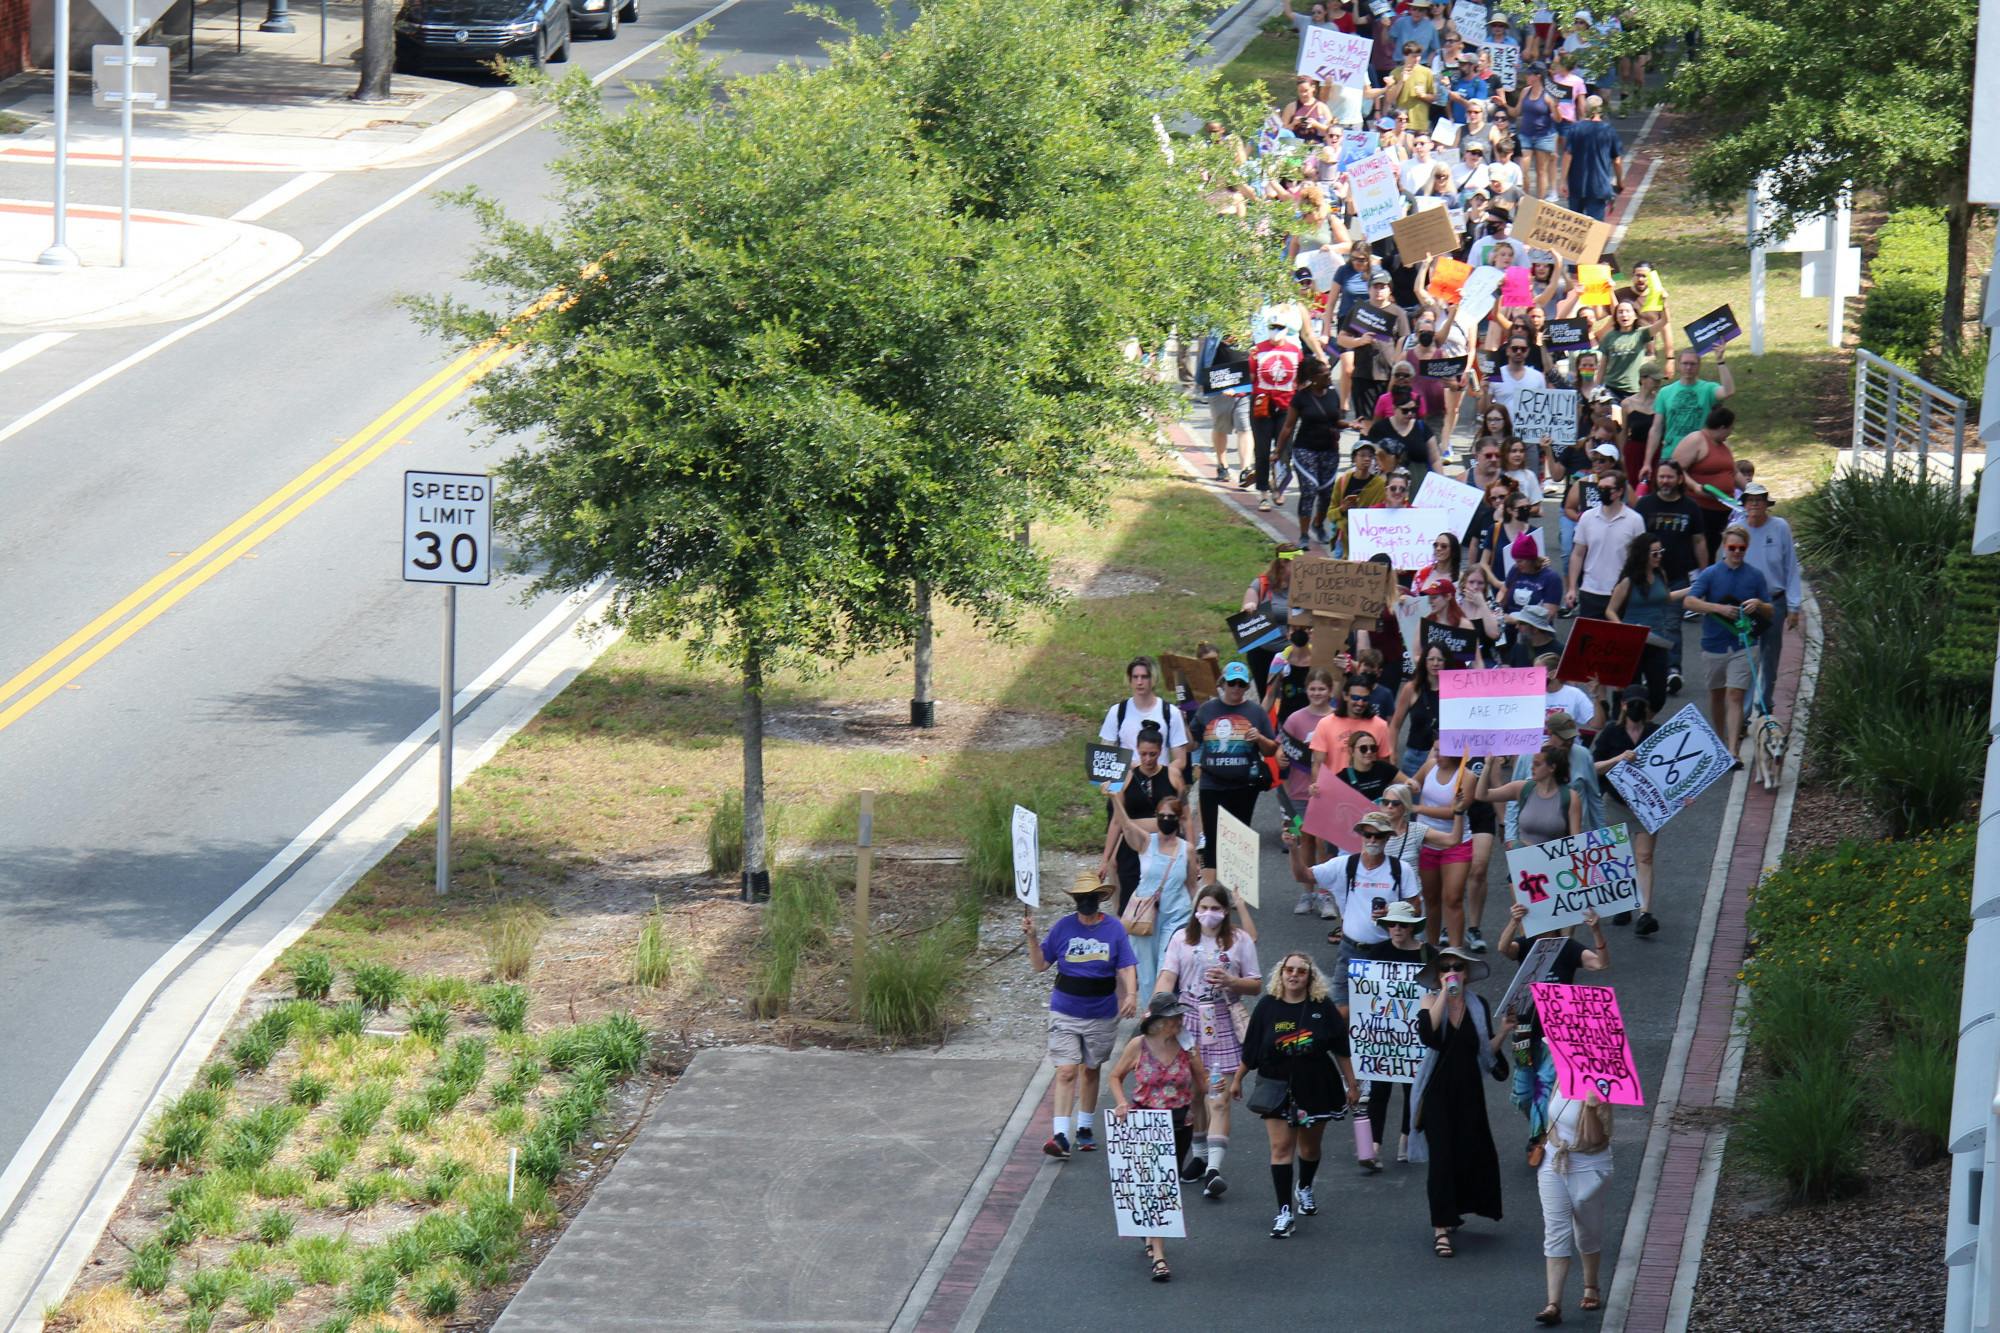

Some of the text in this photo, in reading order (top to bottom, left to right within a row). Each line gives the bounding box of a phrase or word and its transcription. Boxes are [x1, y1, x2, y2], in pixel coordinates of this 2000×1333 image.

[1501, 72, 1514, 87] MY
[1540, 206, 1555, 218] YOU
[1560, 222, 1587, 239] SAFE
[1529, 228, 1587, 255] ABORTION
[1518, 389, 1576, 418] REALLY!
[412, 482, 484, 502] SPEED
[419, 506, 476, 525] LIMIT
[1351, 513, 1411, 537] Womens
[412, 530, 478, 573] 30
[1369, 536, 1411, 552] Rights
[1294, 562, 1382, 579] PROTECT ALL
[1314, 592, 1357, 608] UTERUS
[1428, 625, 1453, 638] BANS
[1452, 671, 1537, 690] SATURDAYS
[1468, 703, 1519, 719] ARE FOR
[1503, 732, 1538, 746] RIGHTS
[1092, 759, 1127, 772] OFF OUR
[1093, 750, 1118, 762] BANS
[1092, 767, 1122, 780] BODIES
[1536, 824, 1629, 861] WE ARE
[1569, 845, 1619, 872] NOT
[1555, 855, 1635, 890] OVARY-
[1551, 878, 1641, 917] ACTING!
[1348, 960, 1372, 979] IF
[1376, 962, 1402, 980] THE
[1352, 976, 1420, 1000] YOU SAVE
[1531, 983, 1613, 1003] WE NEED
[1371, 996, 1414, 1020] GAY
[1540, 999, 1616, 1023] TO TALK
[1275, 1022, 1296, 1033] PRIDE
[1357, 1012, 1420, 1033] WILL YO
[1544, 1012, 1620, 1034] ABOUT THE
[1350, 1025, 1420, 1046] CONTINUE
[1549, 1025, 1624, 1049] ELEPHANT
[1354, 1041, 1411, 1059] PROTECT
[1569, 1043, 1622, 1059] IN THE
[1359, 1055, 1422, 1079] RIGHT
[1569, 1055, 1630, 1079] WOMB
[1142, 1111, 1168, 1128] LIKE
[1113, 1127, 1173, 1142] ABORTION?
[1108, 1140, 1176, 1156] JUST IGNORE
[1111, 1168, 1177, 1183] LIKE YOU DO
[1113, 1183, 1178, 1198] ALL THE KIDS
[1116, 1196, 1182, 1211] IN FOSTER
